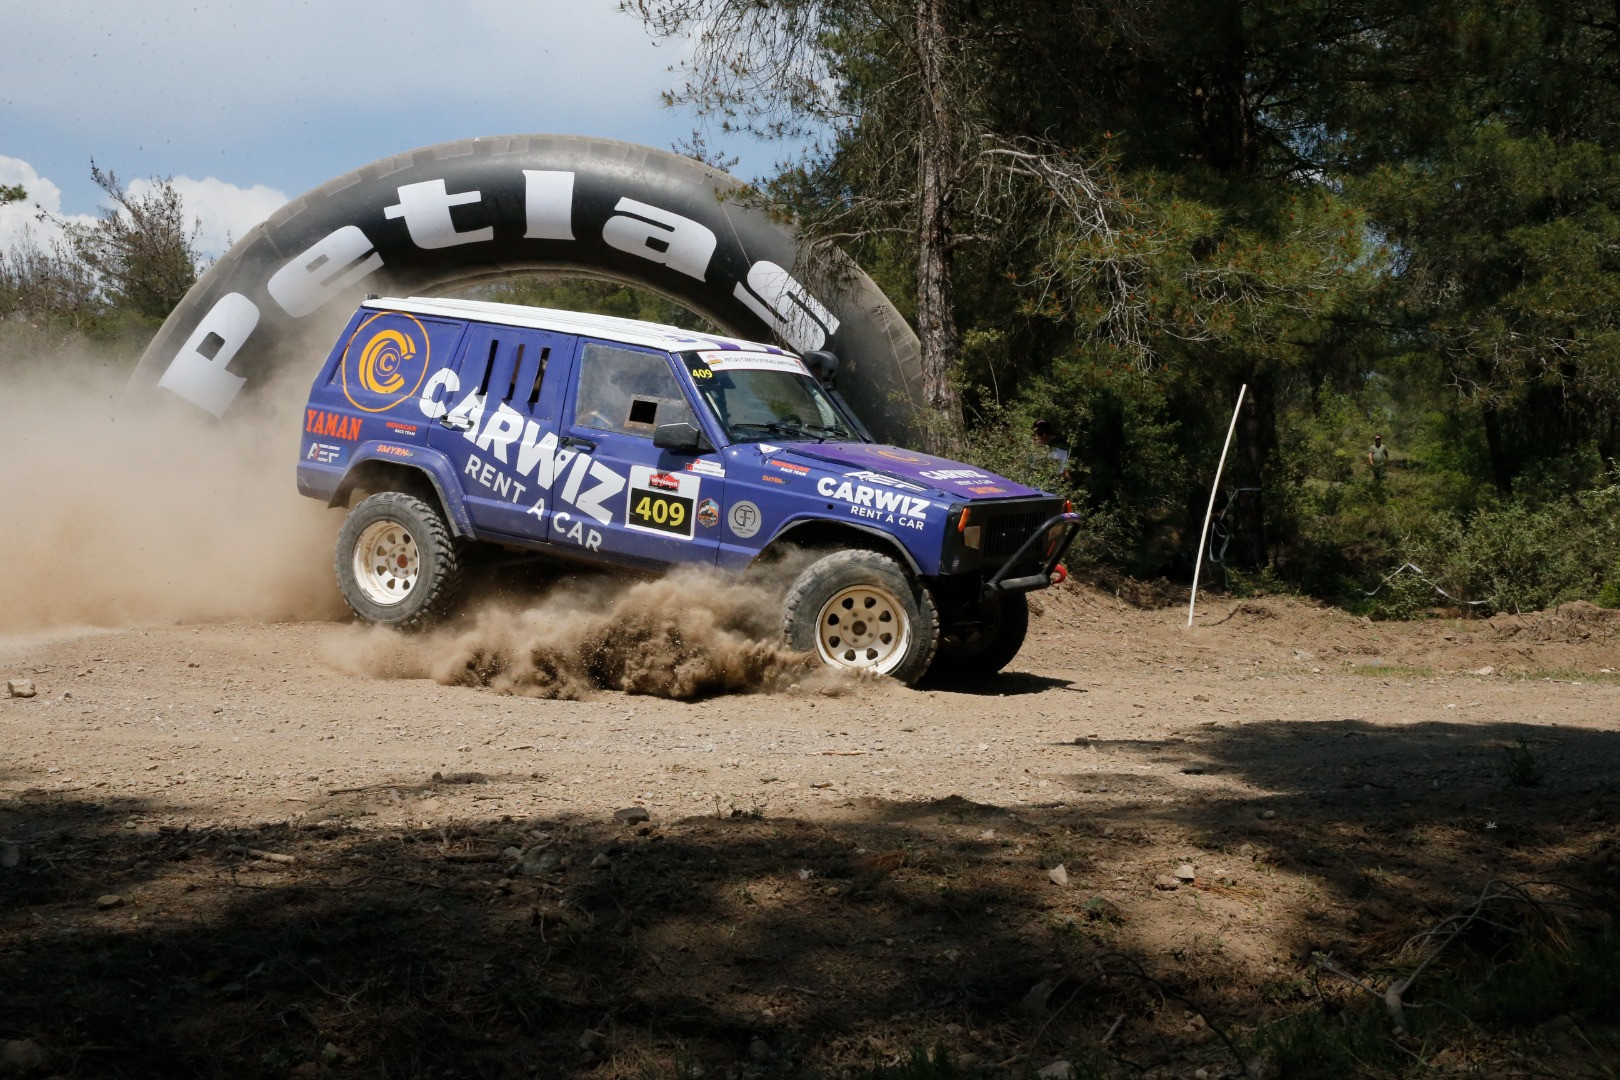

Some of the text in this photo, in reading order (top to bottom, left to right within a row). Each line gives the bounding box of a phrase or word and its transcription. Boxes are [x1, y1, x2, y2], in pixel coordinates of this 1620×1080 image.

[157, 169, 841, 418] Petlas
[692, 369, 713, 379] 409
[305, 409, 363, 441] YAMAN
[419, 367, 627, 526] CARWIZ
[464, 454, 603, 552] RENT A CAR
[635, 496, 685, 527] 409
[817, 477, 931, 520] CARWIZ
[850, 505, 925, 531] RENT A CAR
